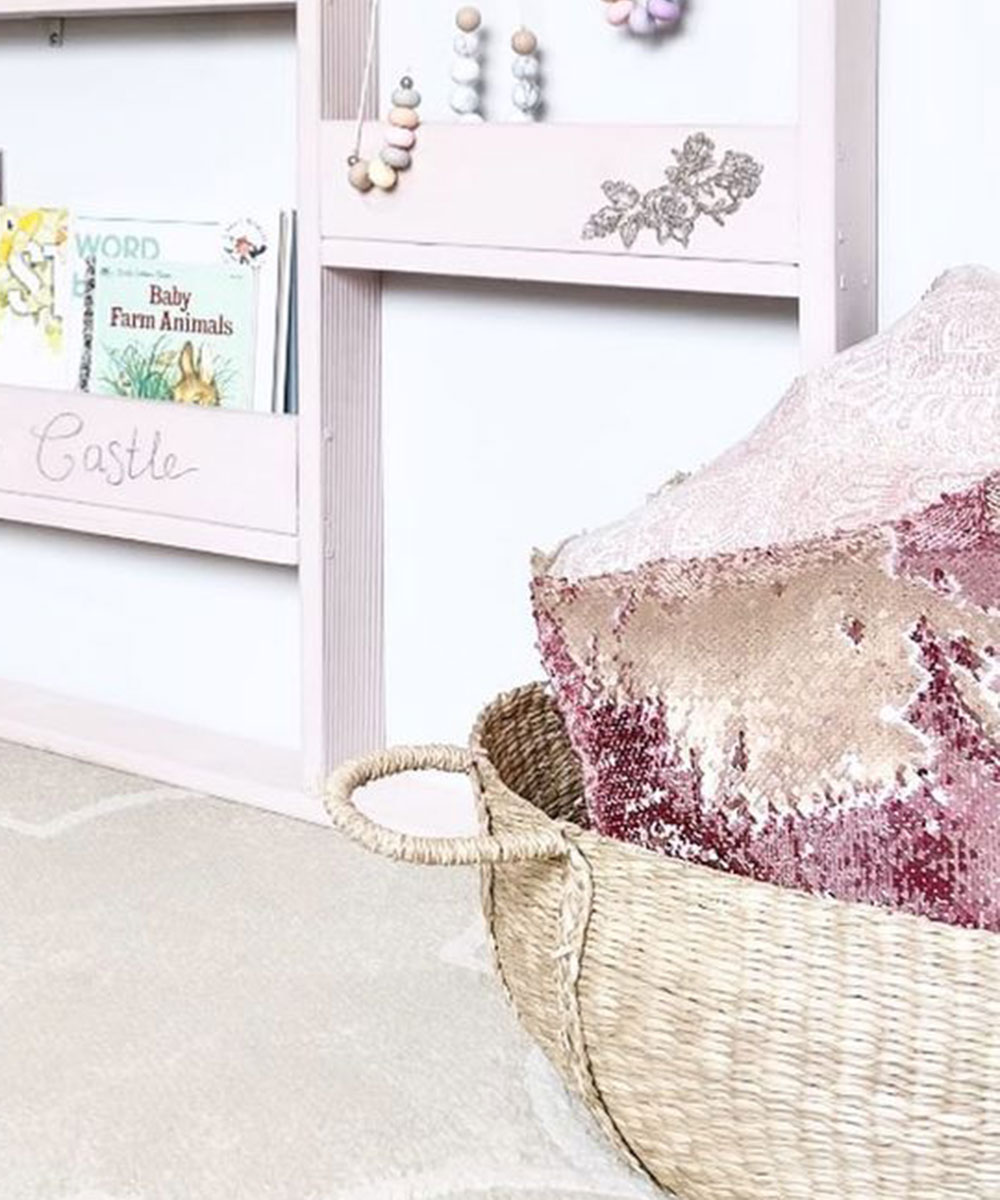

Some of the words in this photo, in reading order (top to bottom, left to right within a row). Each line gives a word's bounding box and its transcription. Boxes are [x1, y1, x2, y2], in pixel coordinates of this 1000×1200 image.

[75, 232, 161, 261] WORD
[149, 283, 193, 312] Baby
[109, 305, 156, 330] Farm
[158, 310, 234, 337] Animals
[30, 411, 200, 486] Castle
